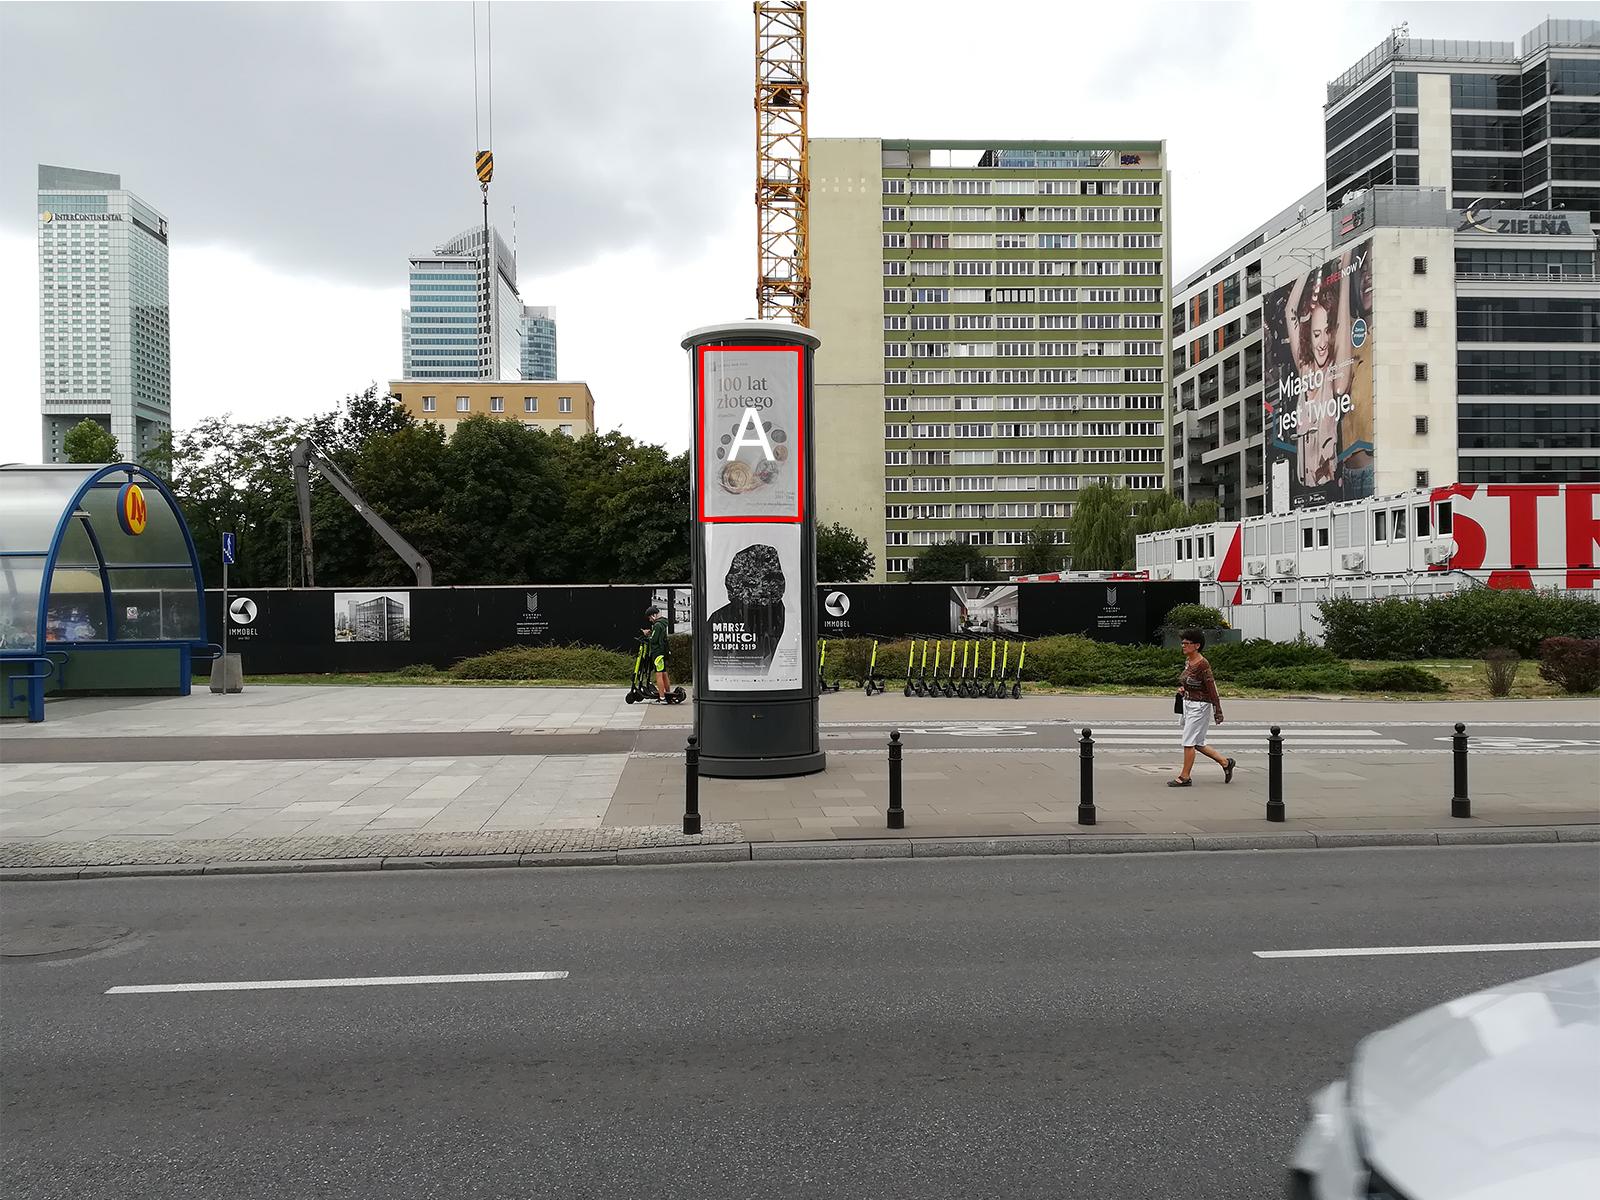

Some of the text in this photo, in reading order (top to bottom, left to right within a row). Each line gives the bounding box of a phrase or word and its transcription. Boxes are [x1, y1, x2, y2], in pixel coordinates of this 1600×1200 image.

[1496, 219, 1573, 235] ZIELNA
[718, 375, 769, 392] 100 lat
[1279, 369, 1324, 401] Miasto
[716, 395, 774, 412] złotego
[1277, 388, 1355, 441] jest Twoje.
[712, 622, 745, 632] MARSZ
[824, 620, 850, 628] IMMOBEL
[228, 628, 258, 636] IMMOBEL
[712, 633, 757, 643] PAMIĘCI
[740, 643, 757, 651] 2019
